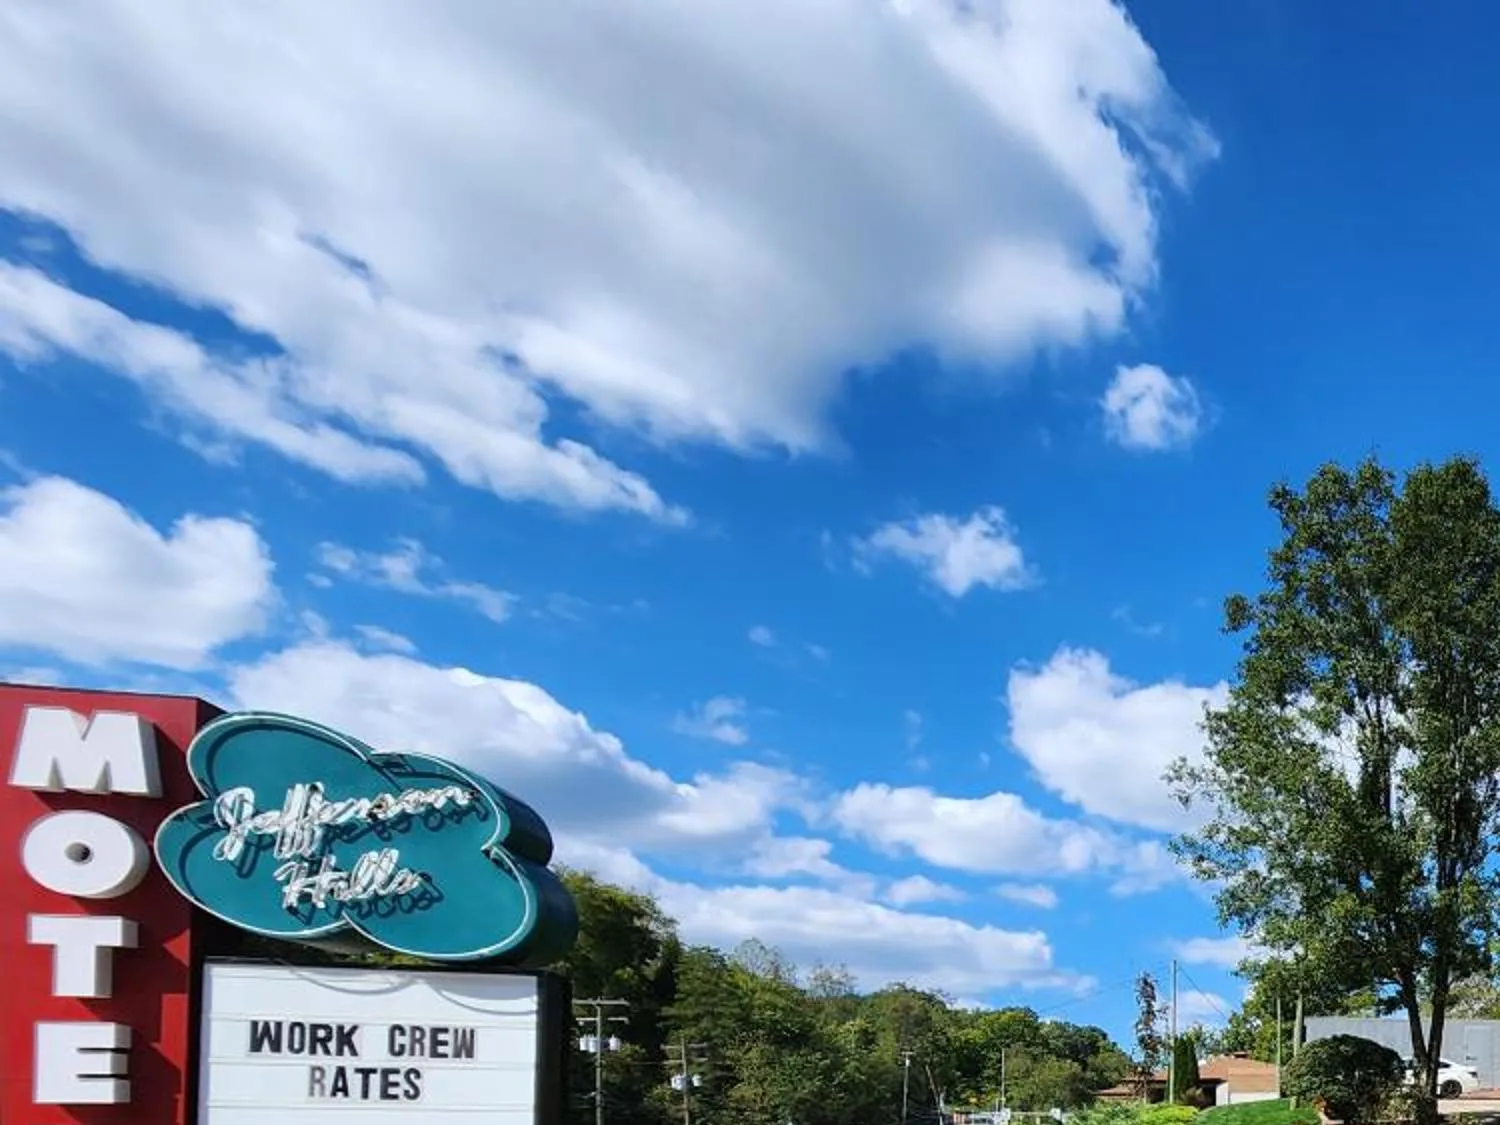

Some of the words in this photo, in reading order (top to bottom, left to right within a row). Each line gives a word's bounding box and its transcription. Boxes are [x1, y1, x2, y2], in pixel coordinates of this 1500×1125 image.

[249, 1019, 359, 1057] WORK
[388, 1024, 475, 1058] CREW
[308, 1066, 422, 1100] RATES
